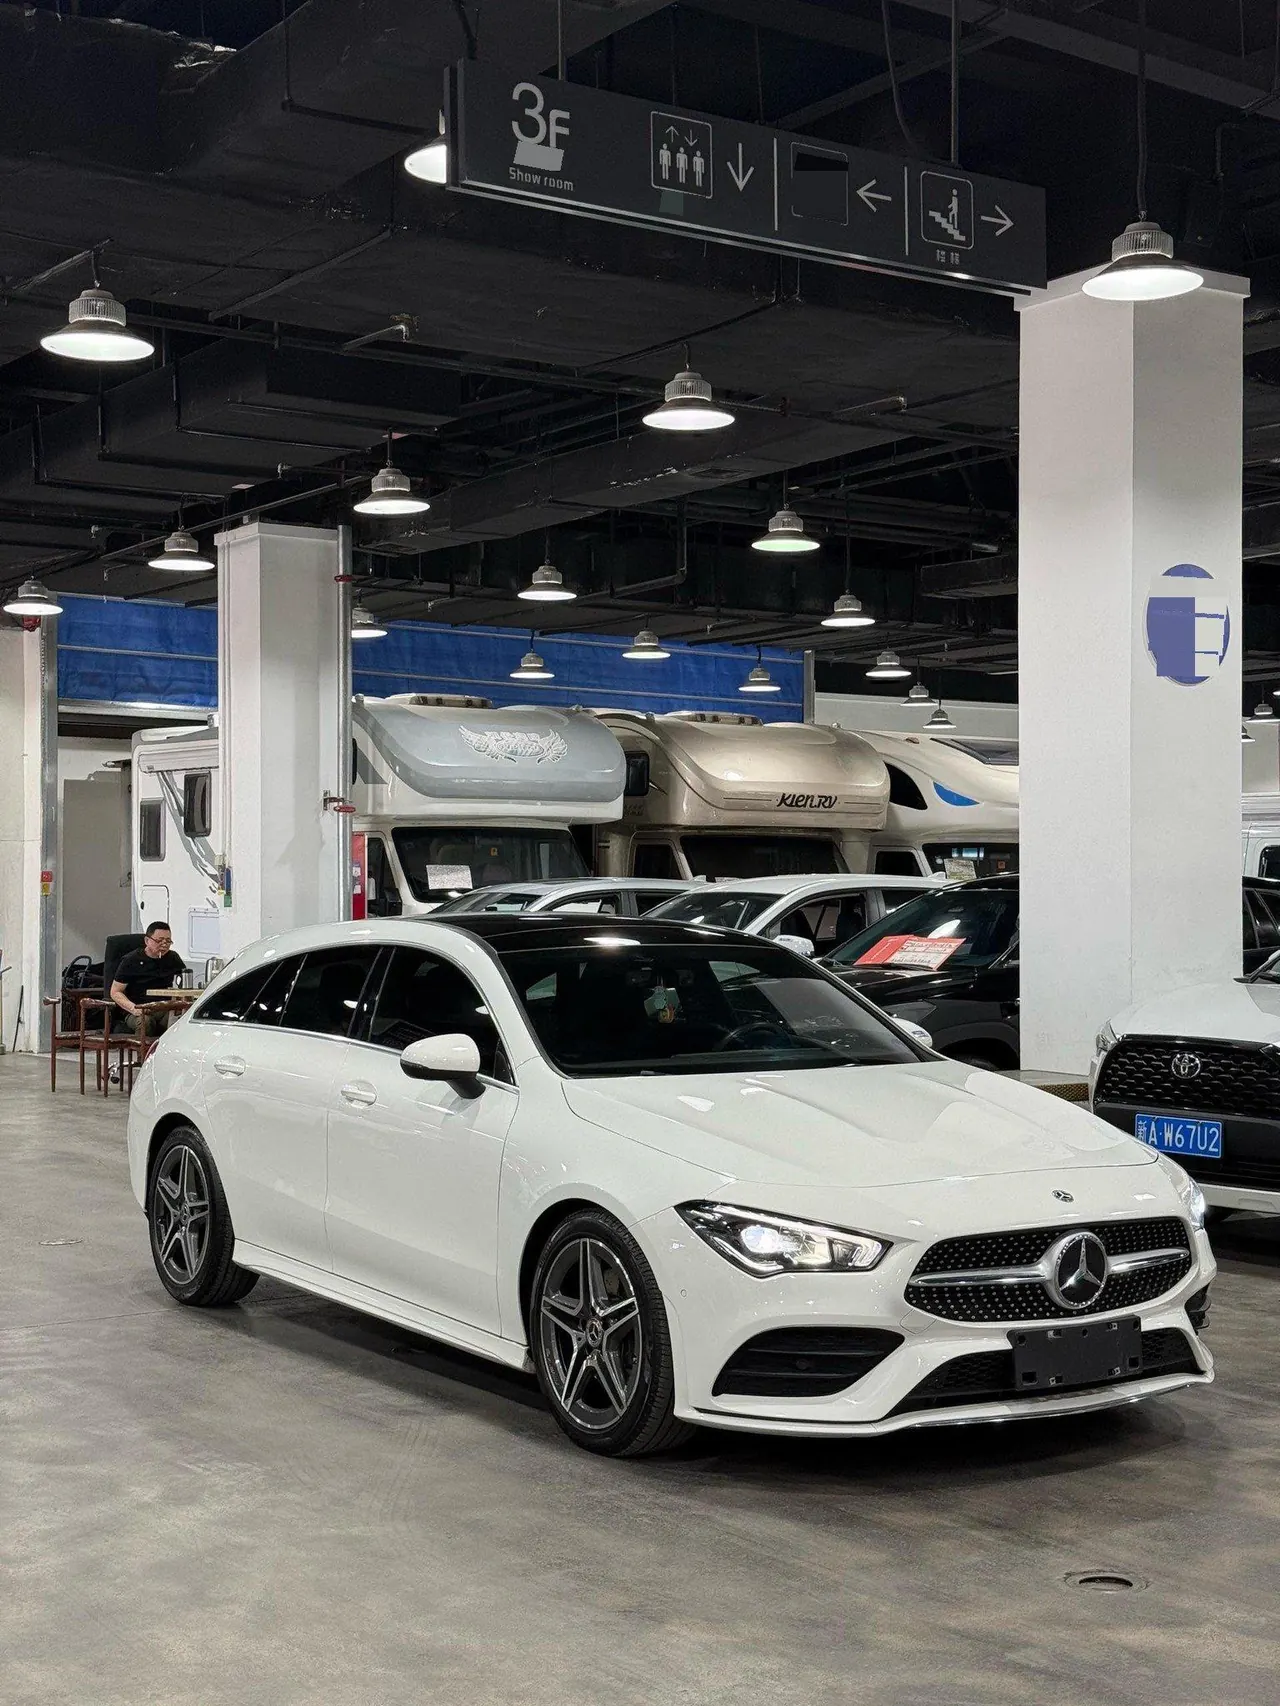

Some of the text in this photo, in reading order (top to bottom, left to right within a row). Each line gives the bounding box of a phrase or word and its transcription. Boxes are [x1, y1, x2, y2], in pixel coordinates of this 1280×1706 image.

[511, 82, 570, 149] 3F
[509, 167, 574, 192] Show room
